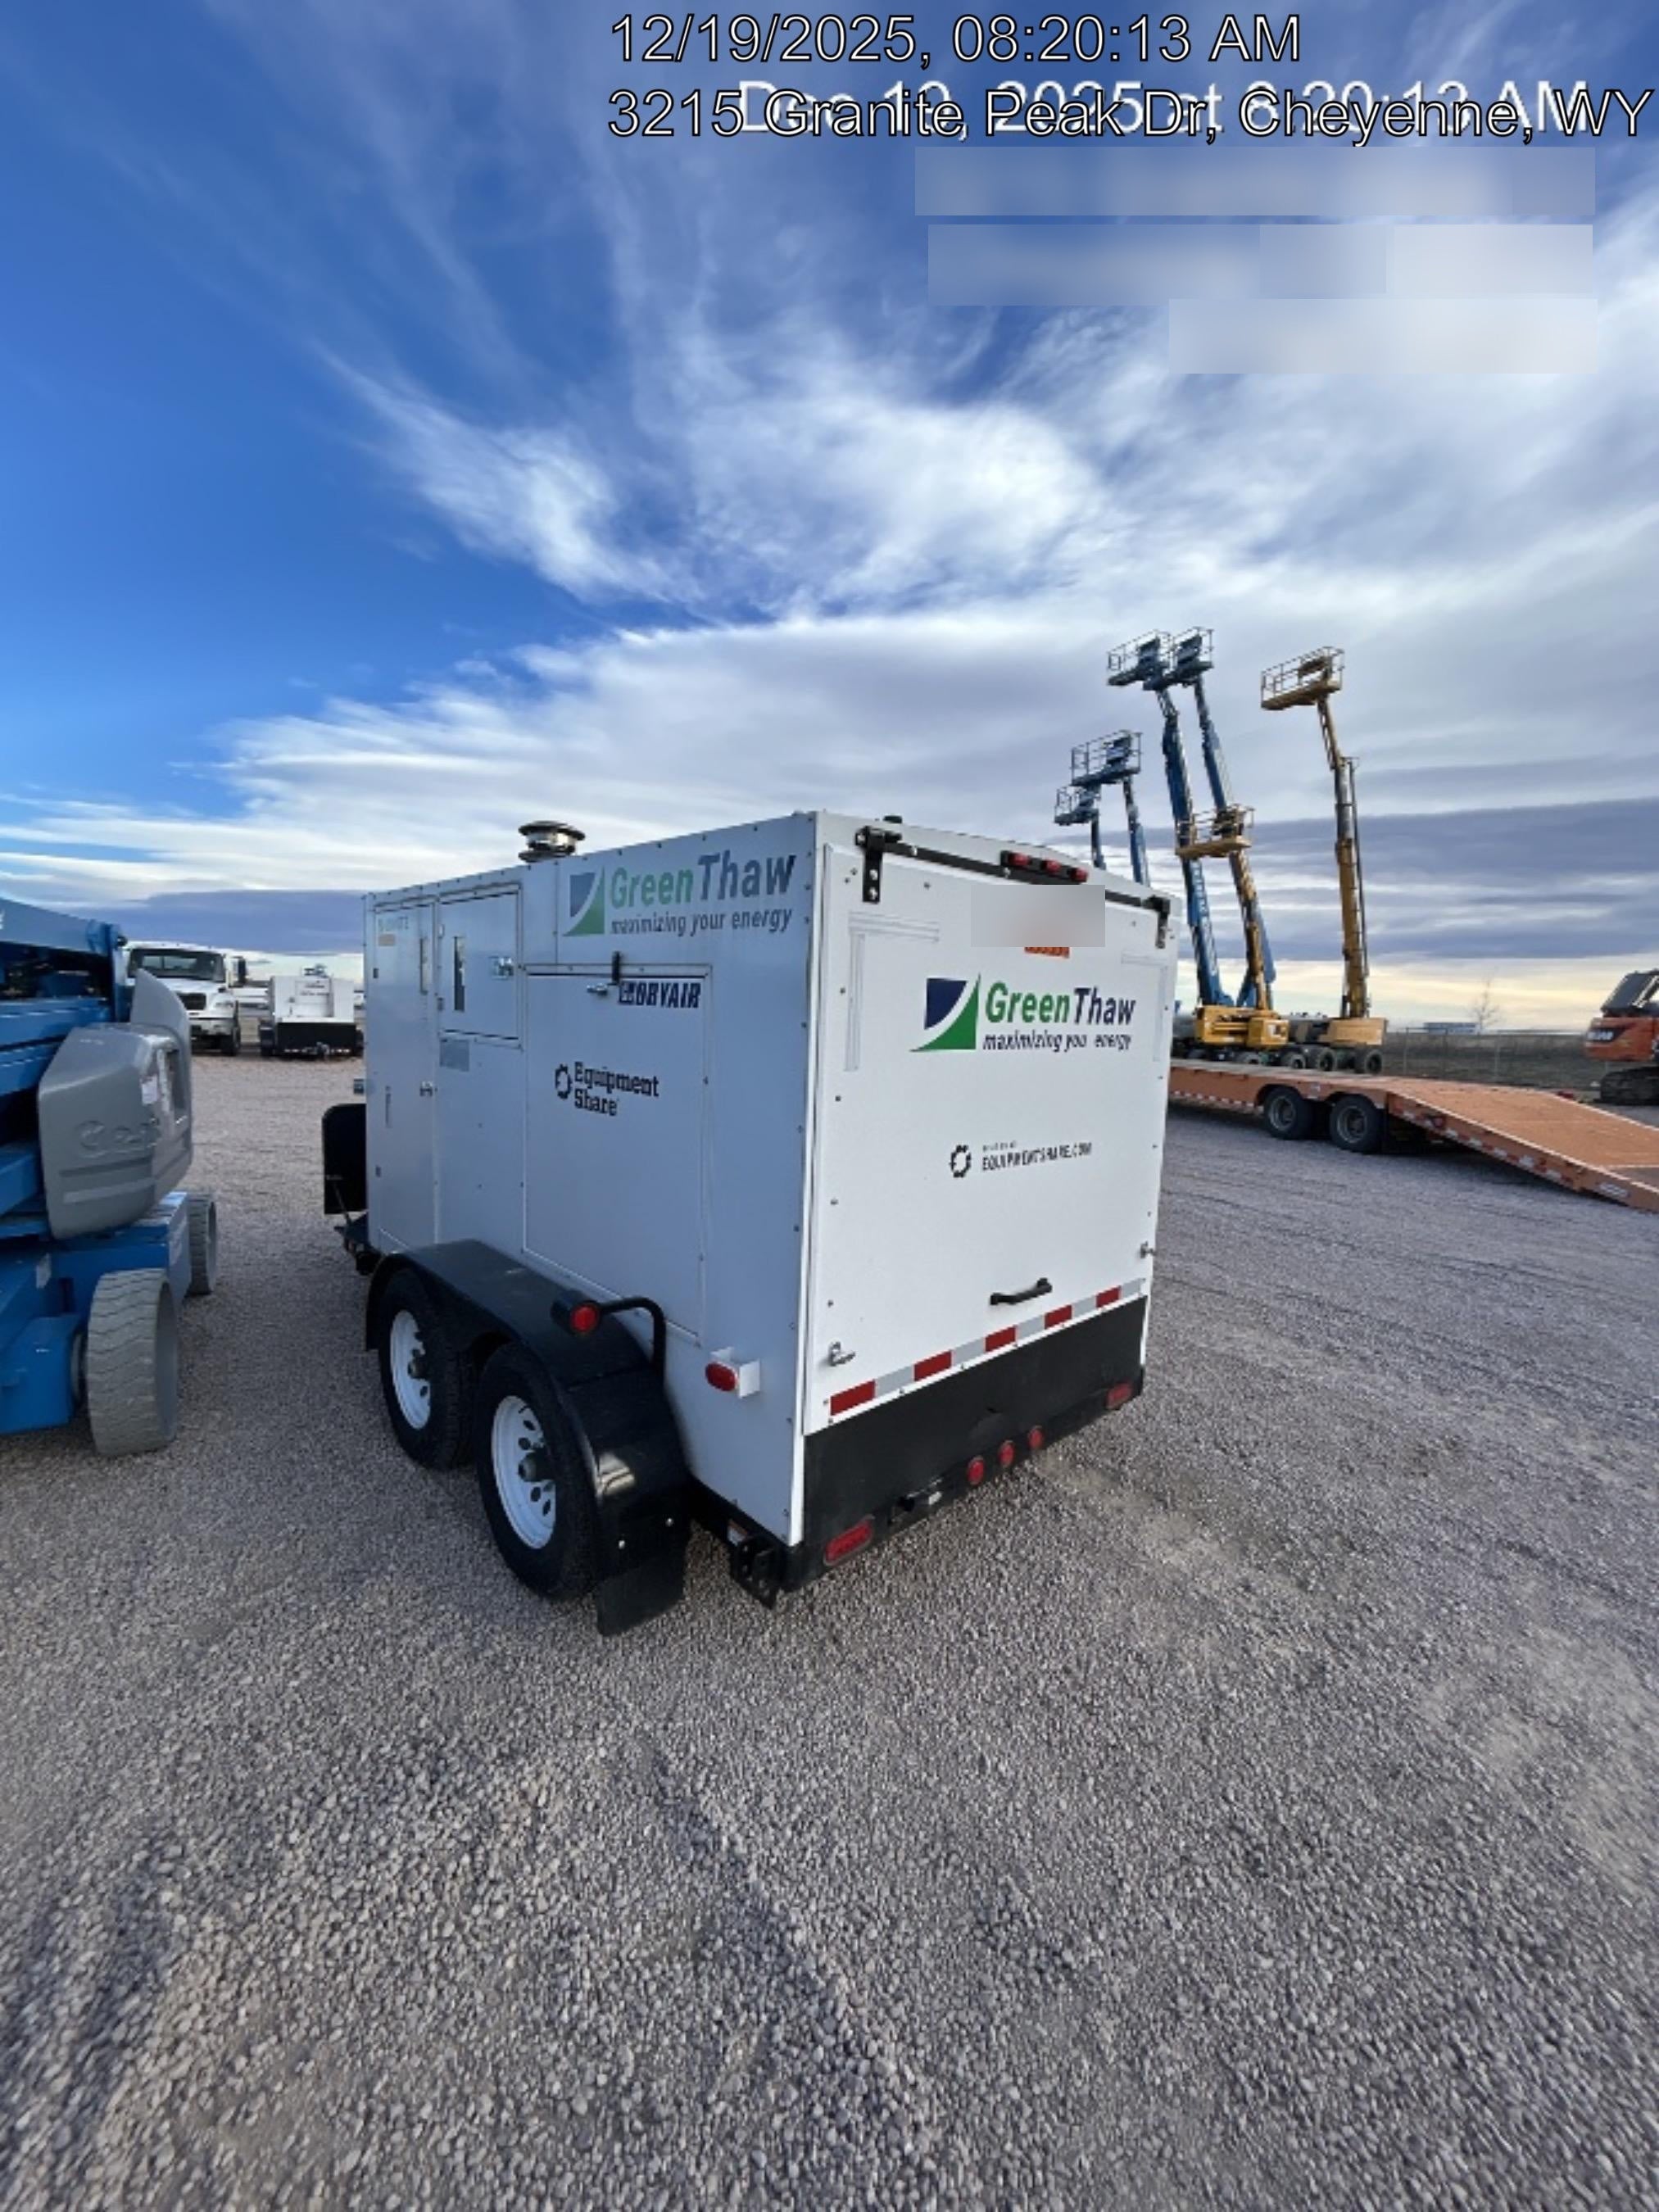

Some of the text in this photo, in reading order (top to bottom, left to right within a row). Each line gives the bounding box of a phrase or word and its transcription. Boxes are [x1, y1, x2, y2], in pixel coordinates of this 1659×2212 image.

[690, 912, 726, 937] your
[732, 907, 792, 933] energy
[982, 1029, 1063, 1053] maximizing
[574, 1061, 660, 1097] Equipment
[574, 1088, 618, 1117] Share
